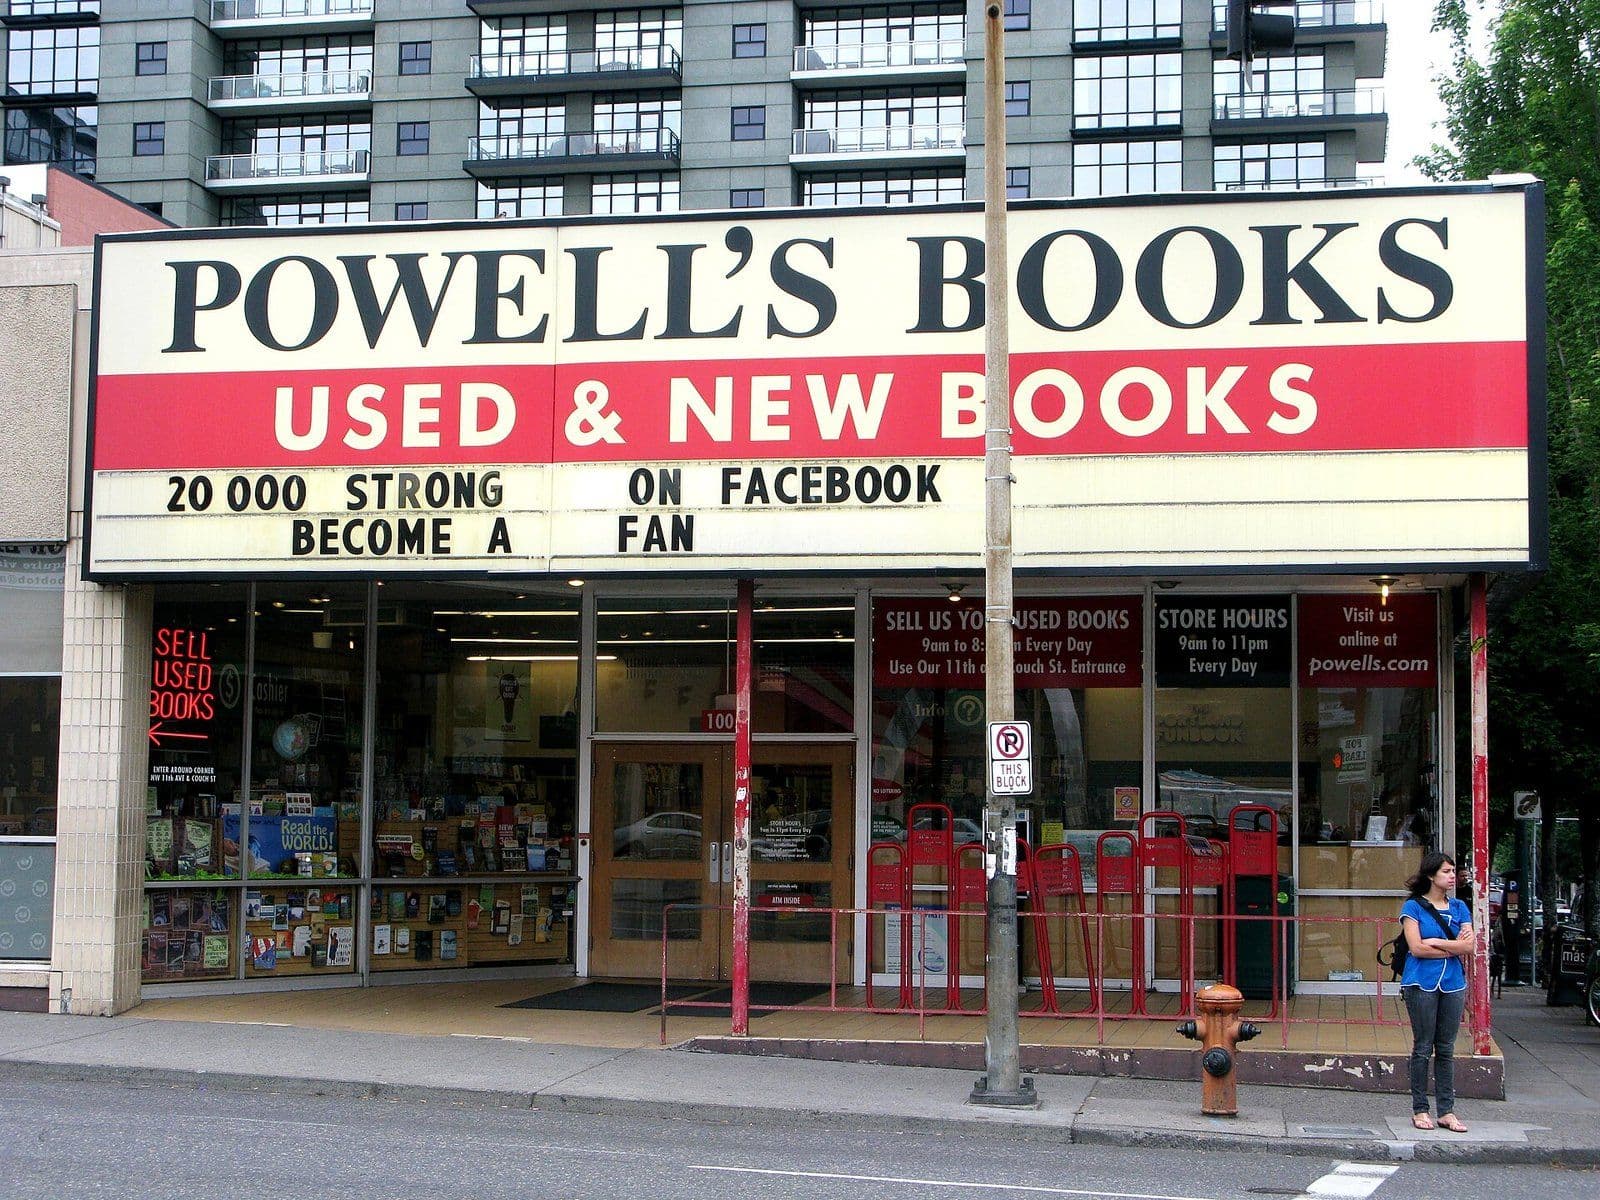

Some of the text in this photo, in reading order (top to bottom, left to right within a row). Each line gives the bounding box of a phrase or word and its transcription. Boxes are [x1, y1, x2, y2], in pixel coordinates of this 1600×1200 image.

[161, 217, 1454, 353] POWELL'S BOOKS
[274, 363, 1318, 451] USED & NEW BOOKS
[347, 471, 503, 511] STRONG
[629, 468, 681, 505] ON
[721, 465, 942, 504] FACEBOOK
[292, 515, 694, 555] BECOME A FAN
[887, 609, 1130, 631] SELL US YO USED BOOKS
[1159, 608, 1288, 629] STORE HOURS
[1343, 606, 1395, 622] Visit us
[155, 628, 212, 660] SELL
[922, 637, 949, 652] 9am
[954, 638, 967, 652] to
[1026, 637, 1062, 655] Every
[1067, 637, 1093, 655] Day
[1178, 634, 1269, 654] 9am to 11pm
[1339, 631, 1398, 647] online at
[889, 660, 912, 674] Use
[917, 660, 941, 674] Our
[947, 659, 976, 674] 11th
[1013, 659, 1044, 674] ouch
[1049, 658, 1067, 674] St.
[1071, 658, 1126, 674] Entrance
[1189, 658, 1258, 677] Every Day
[1309, 654, 1429, 676] powells.com
[154, 660, 213, 692] USED
[253, 673, 289, 703] ashier
[149, 690, 214, 720] BOOKS
[150, 774, 161, 782] NW
[175, 774, 185, 782] AVE
[192, 775, 209, 783] COUCH
[210, 775, 217, 783] ST
[153, 765, 215, 774] ENTER AROUND CORNER
[1001, 763, 1022, 774] THIS
[996, 776, 1027, 788] BLOCK
[281, 819, 311, 835] Read
[312, 824, 328, 835] the
[281, 831, 335, 851] WORLD!
[772, 896, 801, 905] ATM INSIDE
